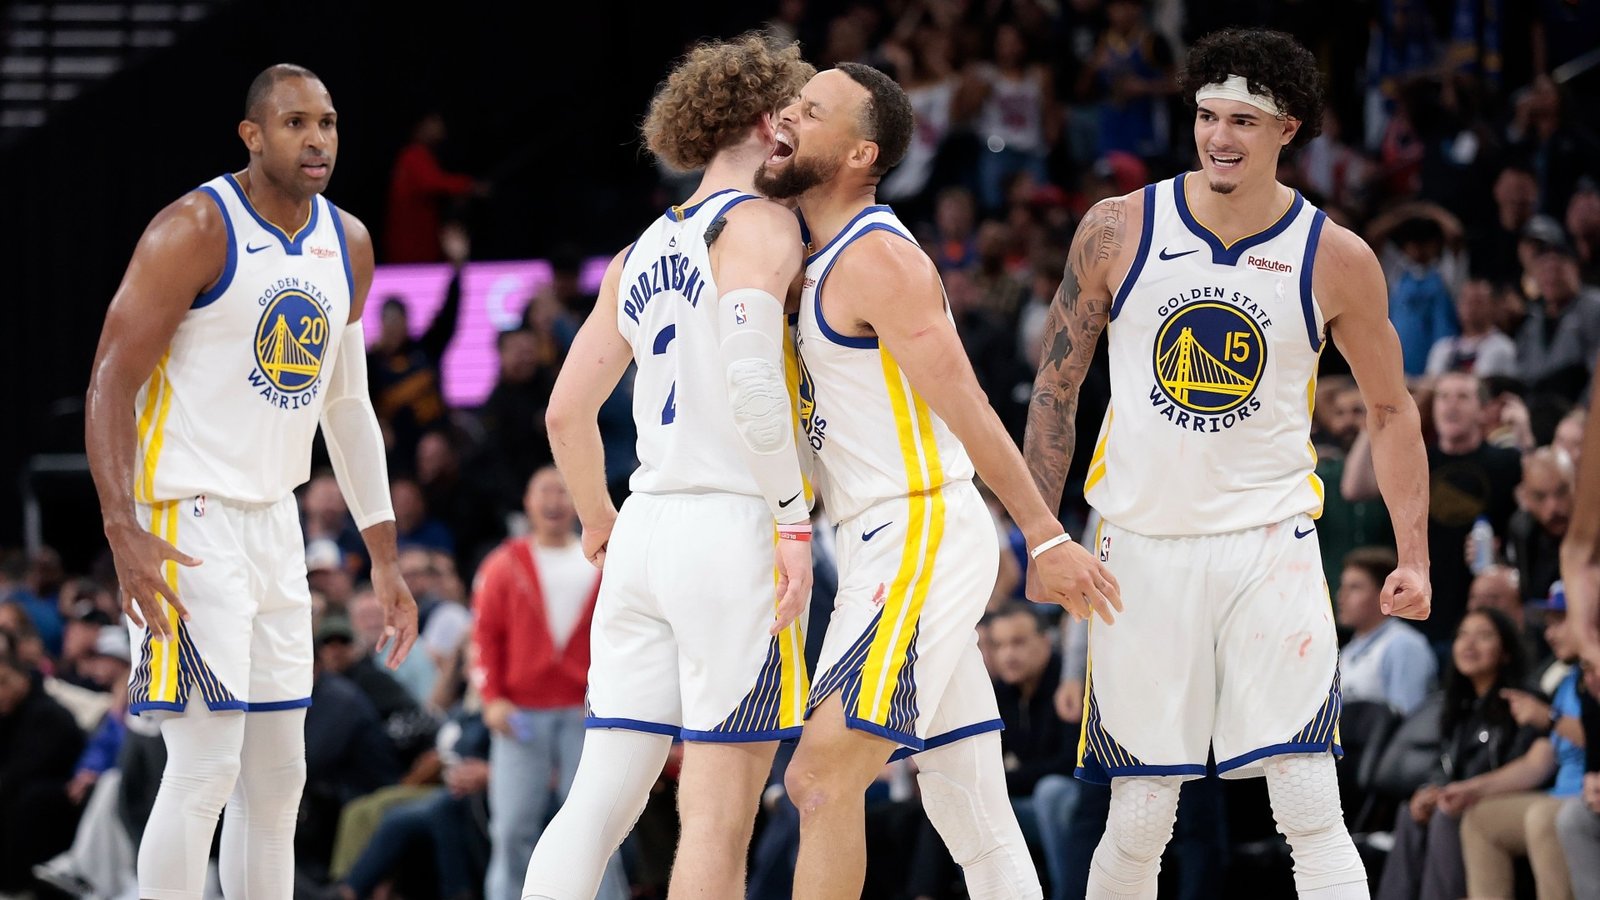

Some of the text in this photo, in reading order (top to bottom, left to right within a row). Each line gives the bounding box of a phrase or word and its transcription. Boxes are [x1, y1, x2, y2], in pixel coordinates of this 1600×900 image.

[1247, 256, 1293, 273] Rakuten
[258, 277, 334, 313] GOLDEN STATE
[623, 252, 705, 326] PODZIESKI
[1157, 286, 1273, 330] GOLDEN STATE
[298, 315, 325, 345] 20
[1224, 331, 1252, 363] 15
[247, 367, 322, 410] WARRIOR
[1149, 384, 1262, 433] WARRIORS
